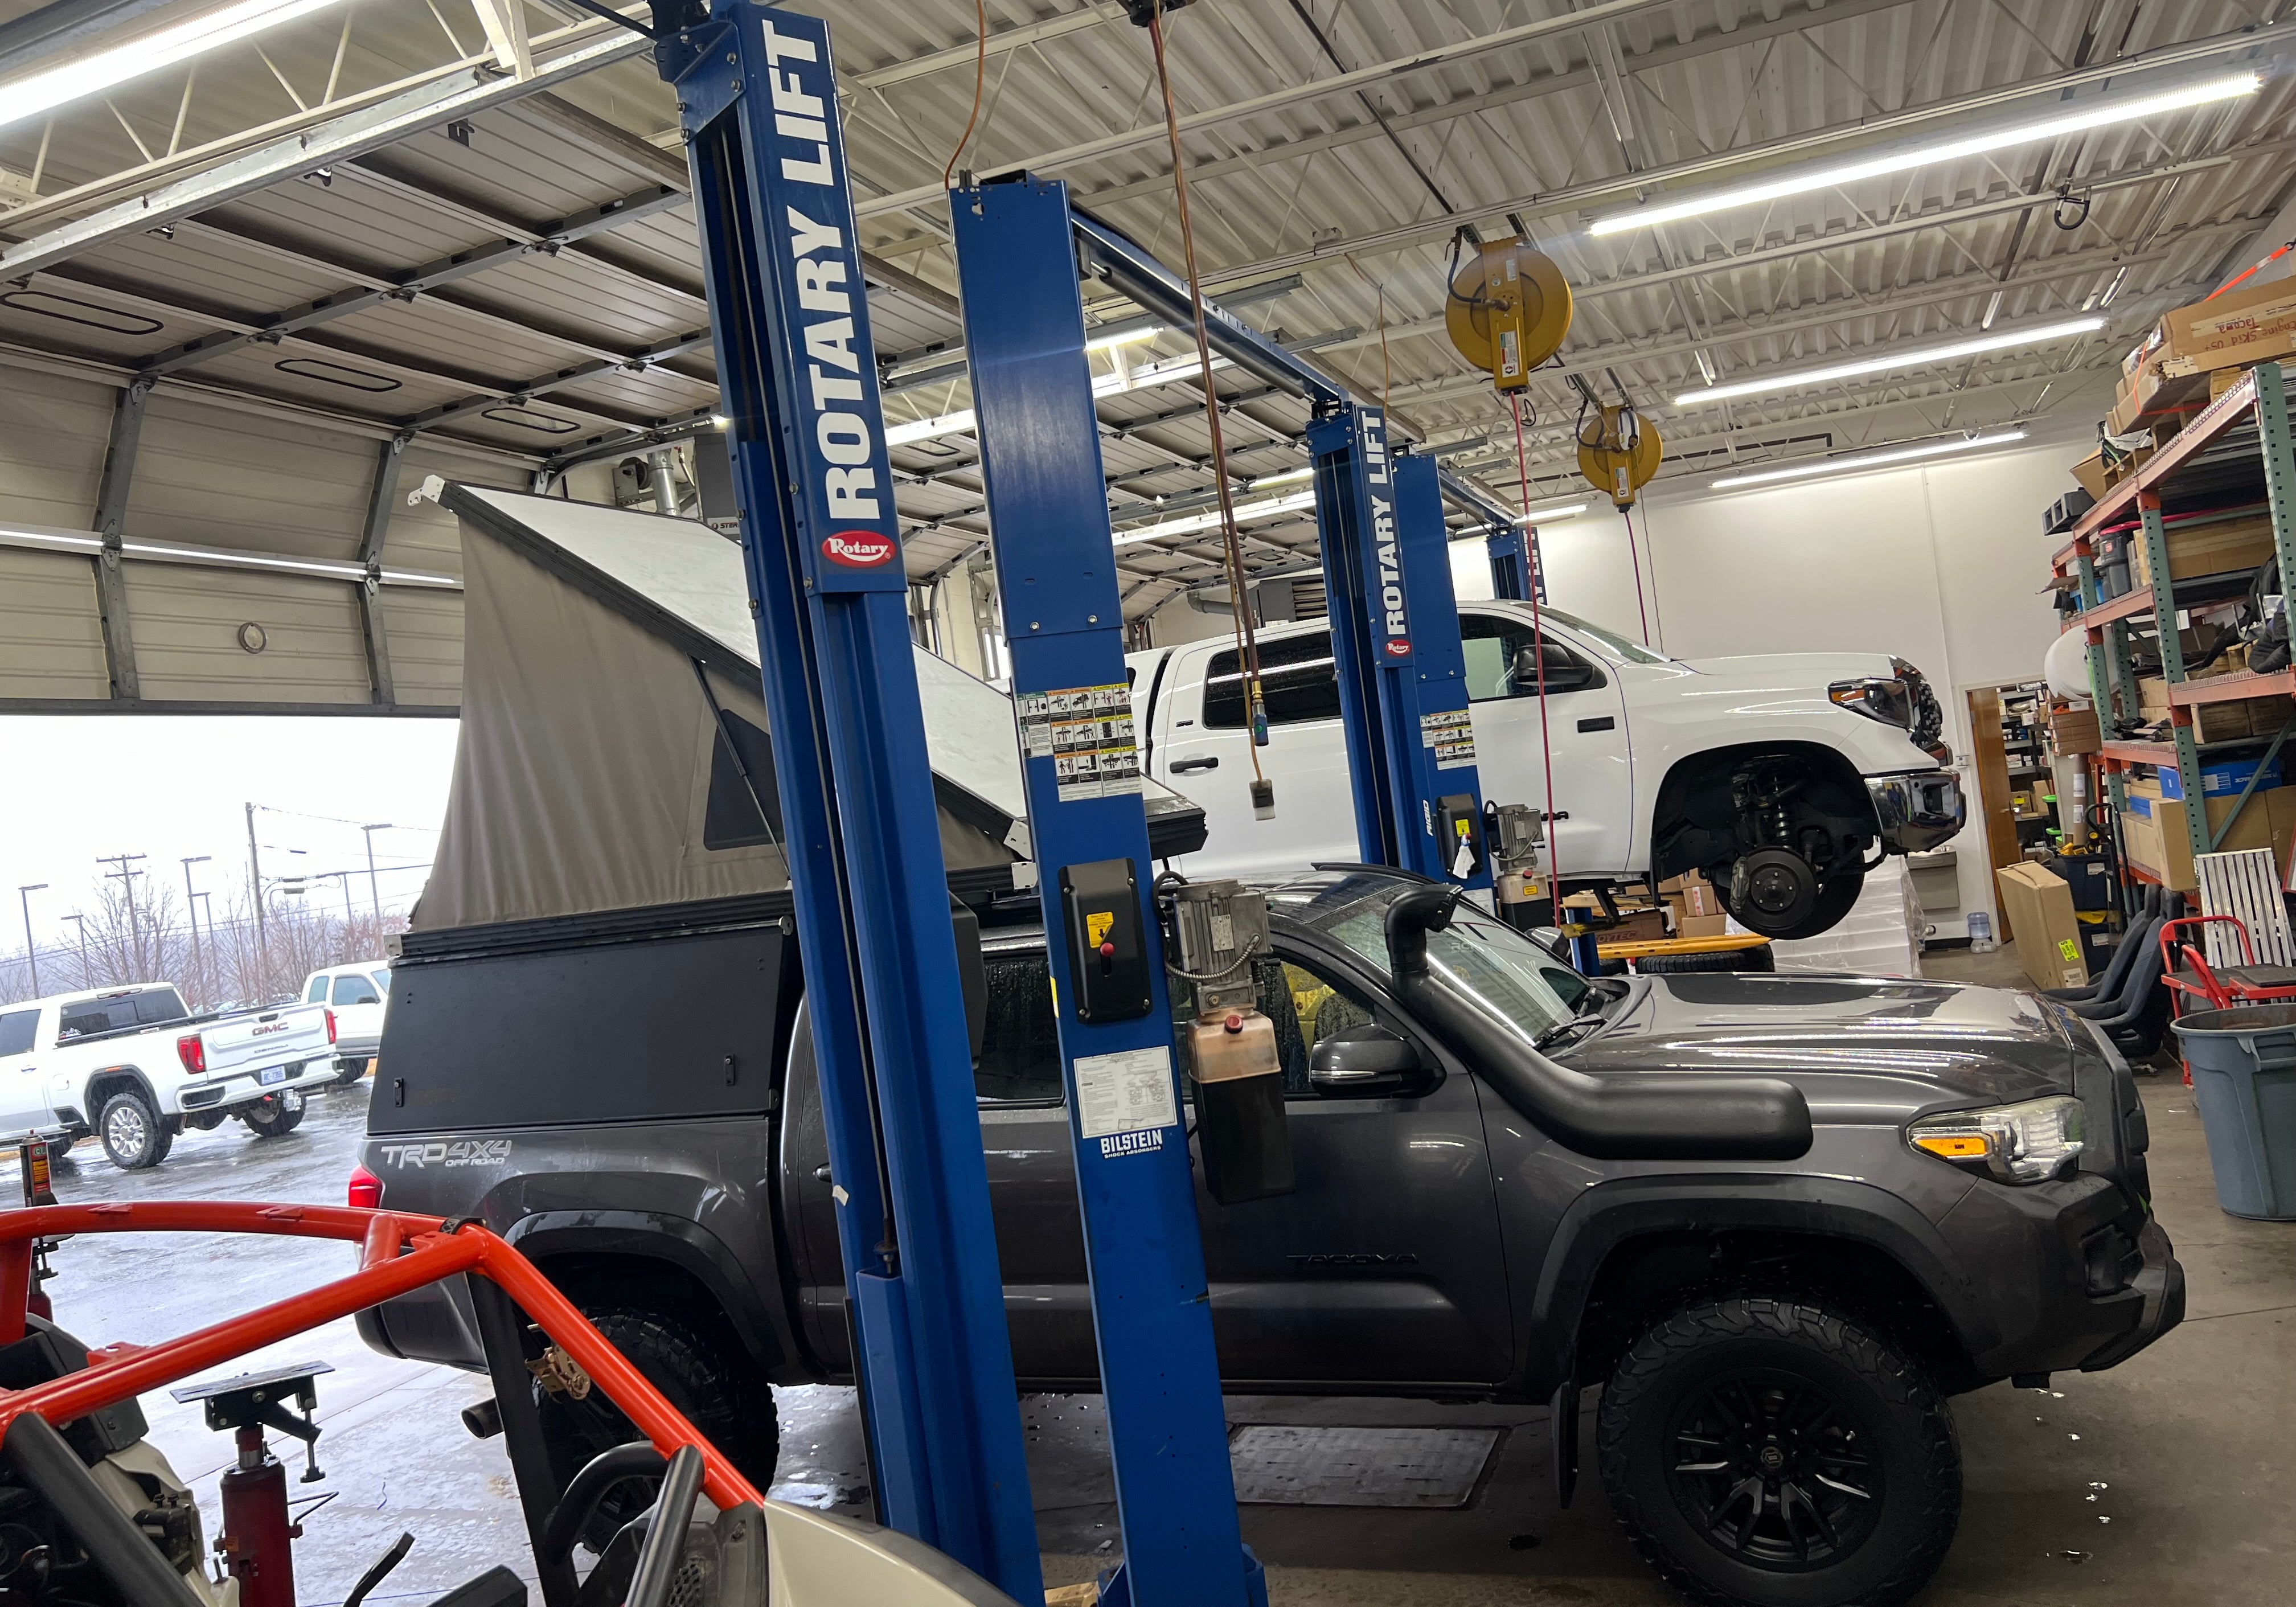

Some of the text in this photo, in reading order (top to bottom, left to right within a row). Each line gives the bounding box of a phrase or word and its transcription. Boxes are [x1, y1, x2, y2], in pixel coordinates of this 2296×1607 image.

[762, 19, 881, 520] ROTARY LIFT
[1363, 411, 1407, 636] ROTARY LIFT
[827, 538, 889, 562] Rotary
[1523, 530, 1540, 576] LIFT
[1387, 643, 1409, 654] Rotary
[1423, 800, 1433, 837] RIGID
[1596, 931, 1637, 944] OYTEC
[252, 1022, 289, 1036] GMC
[254, 1044, 288, 1053] DENALI
[1100, 1129, 1163, 1154] BILSTEIN
[1104, 1145, 1161, 1159] SHOCK ABSORBERS
[381, 1139, 512, 1169] TRD 4X4
[445, 1157, 505, 1167] OFF ROAD
